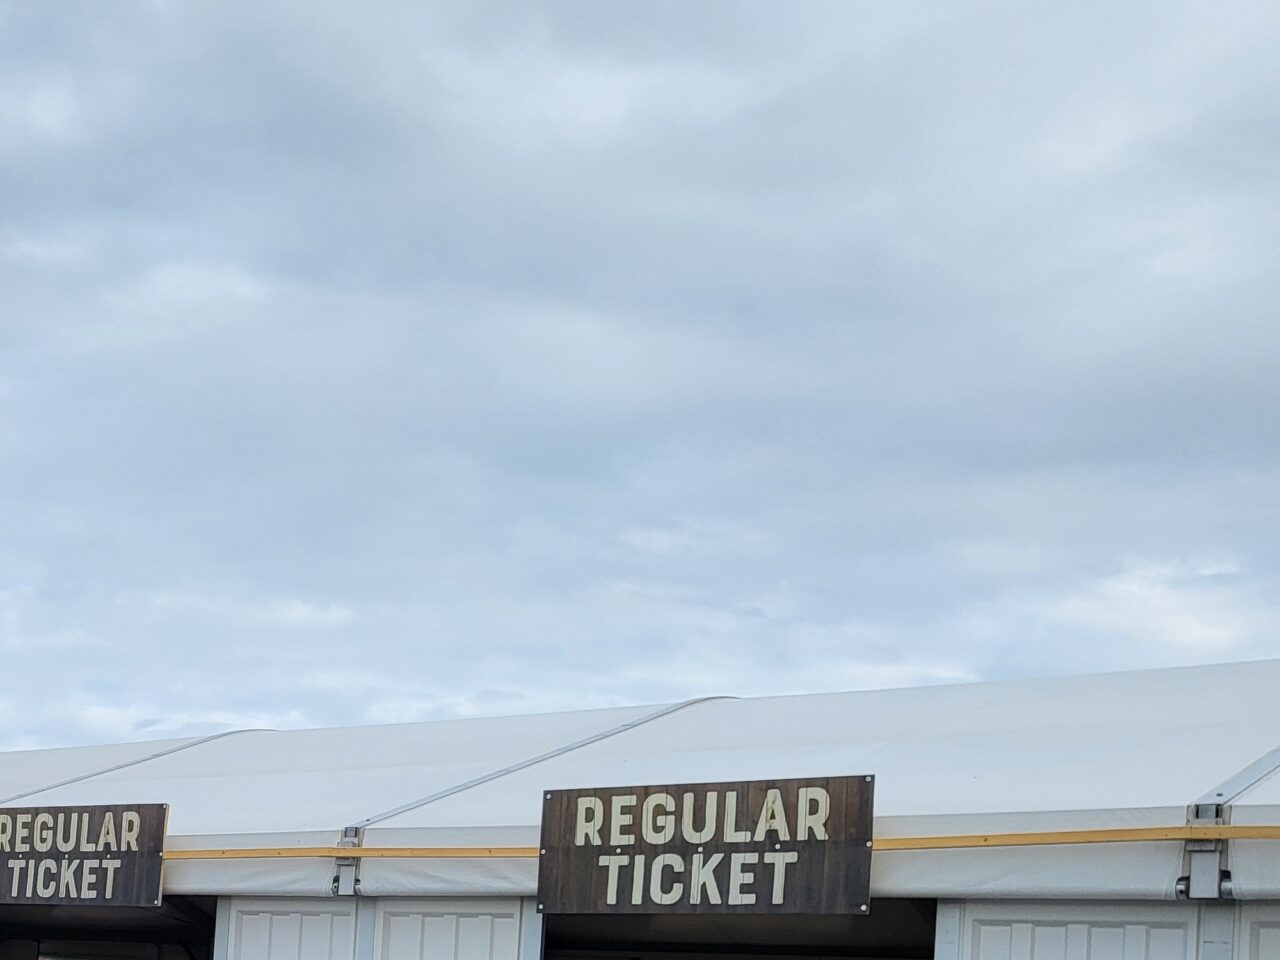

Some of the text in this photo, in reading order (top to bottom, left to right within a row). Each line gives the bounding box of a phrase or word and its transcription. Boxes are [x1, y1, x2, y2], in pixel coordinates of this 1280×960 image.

[575, 787, 831, 847] REGULAR
[7, 858, 121, 899] TICKET
[598, 851, 798, 905] TICKET
